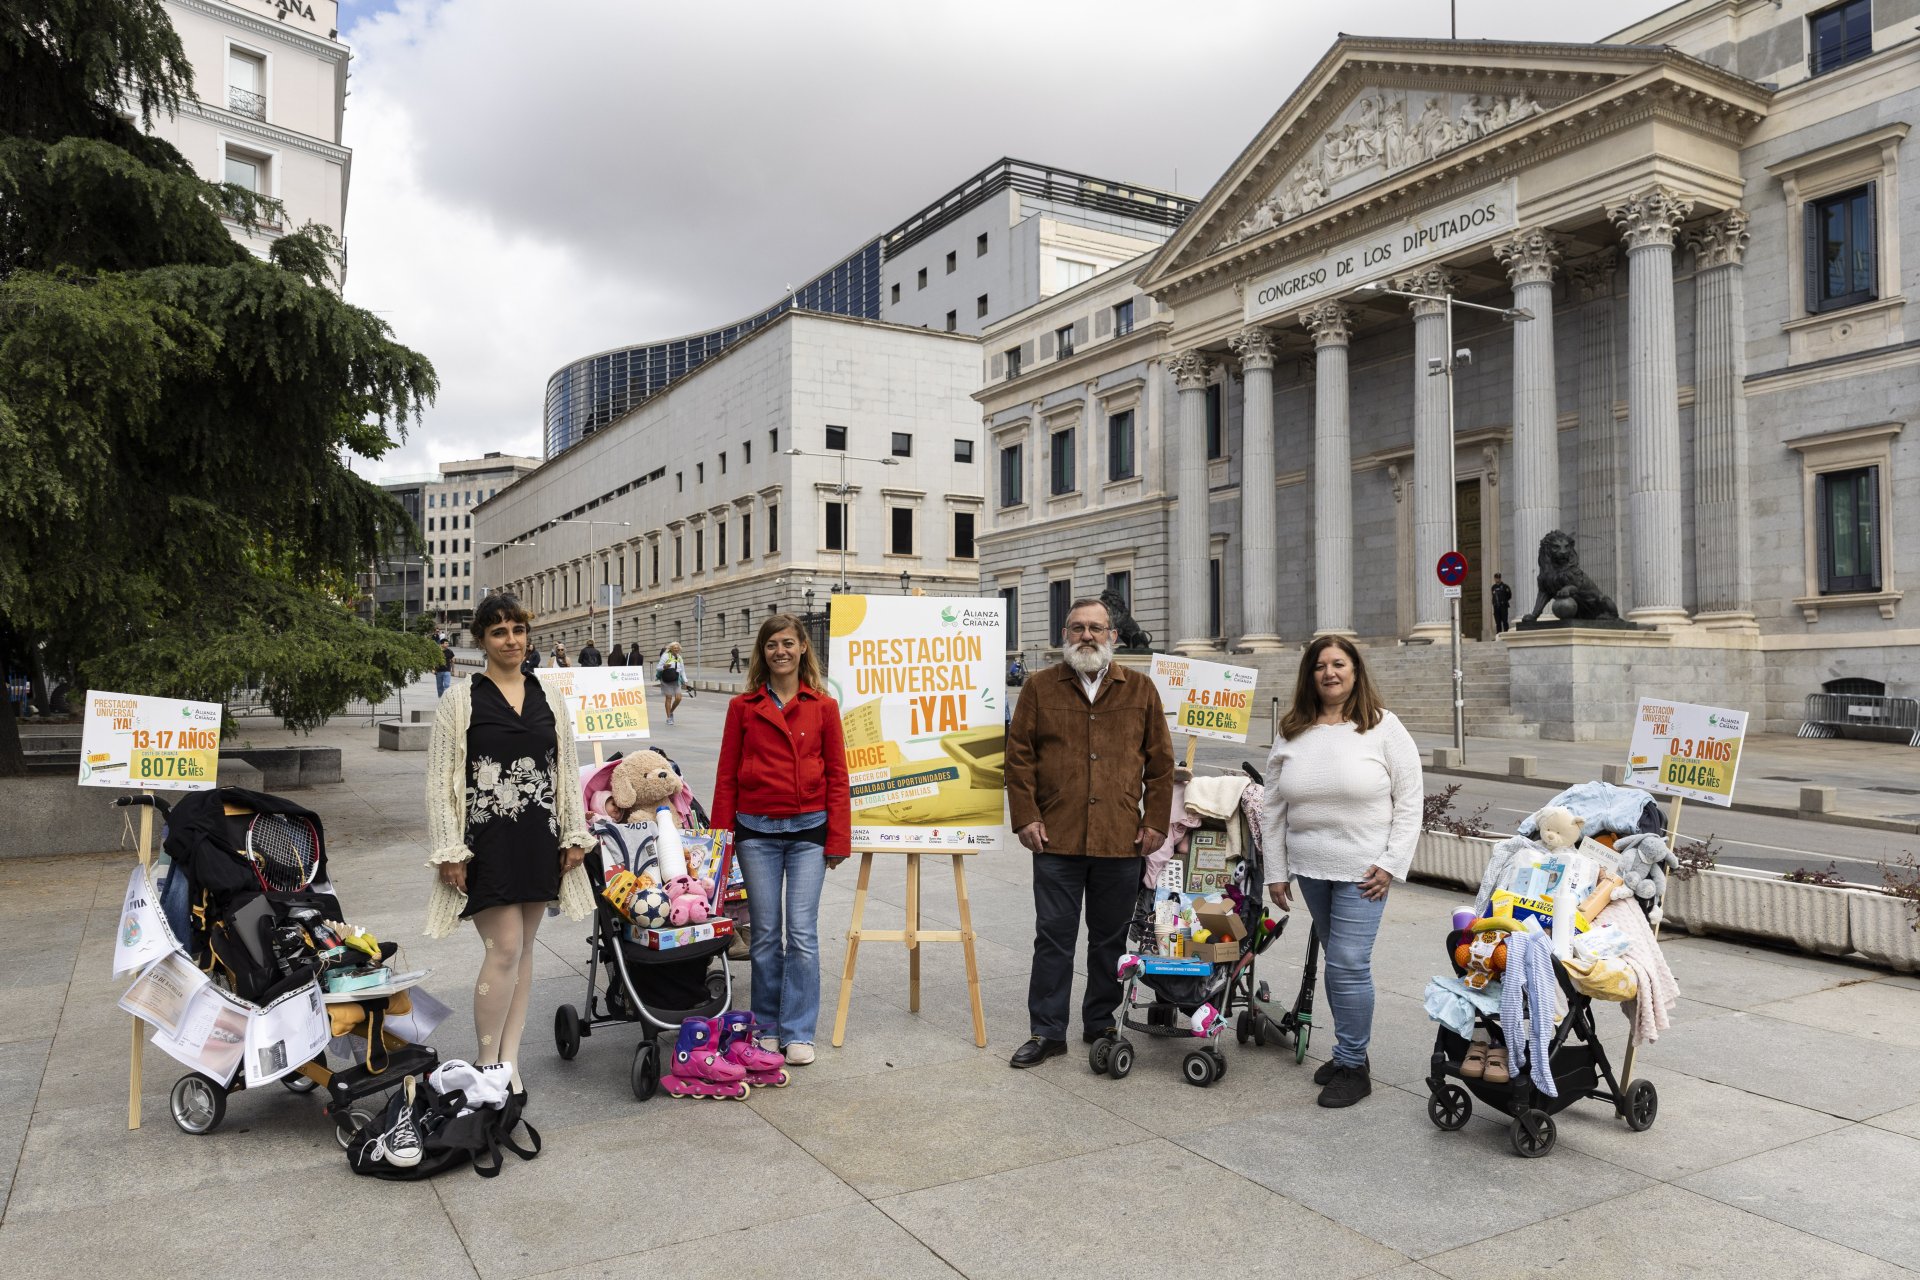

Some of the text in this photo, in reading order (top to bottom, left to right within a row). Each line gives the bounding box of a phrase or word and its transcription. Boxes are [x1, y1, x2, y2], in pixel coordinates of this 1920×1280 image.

[265, 0, 316, 21] ANA
[1258, 204, 1496, 305] CONGRESO DE LOS DIPUTADOS
[963, 609, 999, 618] ALIANZA
[962, 618, 1000, 627] CRIANZA
[849, 631, 981, 666] PRESTACIÓN
[1157, 668, 1186, 677] UNIVERSAL
[856, 664, 977, 695] UNIVERSAL
[1168, 676, 1184, 686] ¡YA!
[560, 686, 573, 696] YA!
[94, 699, 138, 708] PRESTACIÓN
[579, 689, 643, 710] 7-12 AÑOS
[1188, 688, 1246, 708] 4-6 AÑOS
[96, 708, 135, 718] UNIVERSAL
[910, 694, 968, 736] ¡YA!
[1642, 705, 1674, 715] PRESTACIÓN
[113, 718, 132, 730] ¡YA!
[586, 712, 624, 731] 812€
[624, 719, 637, 727] MES
[1187, 710, 1224, 727] 692€
[1642, 714, 1671, 723] UNIVERSAL
[1224, 721, 1237, 729] MES
[1653, 724, 1668, 735] ¡YA!
[132, 728, 216, 749] 13-17 AÑOS
[1670, 737, 1732, 761] 0-3 AÑOS
[188, 758, 197, 766] AL
[846, 745, 887, 769] URGE
[141, 757, 187, 777] 807€
[188, 767, 204, 776] MES
[1707, 768, 1715, 777] AL
[850, 771, 888, 783] CRECER CON
[1668, 764, 1706, 786] 604€
[852, 772, 951, 795] IGUALDAD DE OPORTUNIDADES
[1706, 778, 1720, 788] MES
[854, 786, 931, 806] EN TODAS LAS FAMILIAS
